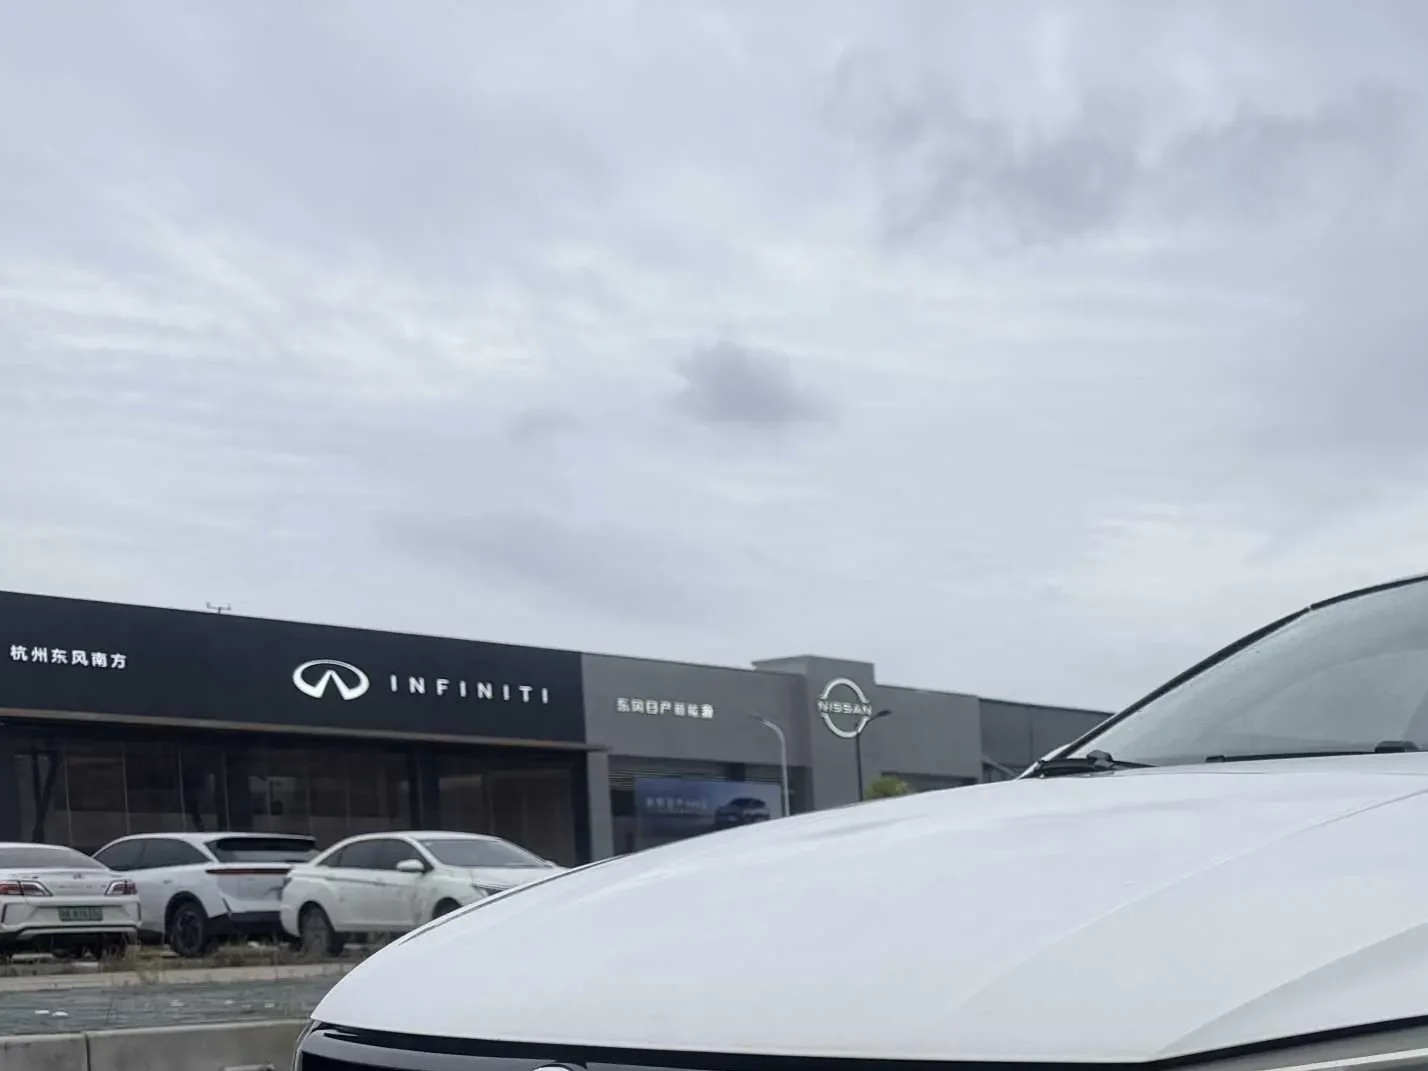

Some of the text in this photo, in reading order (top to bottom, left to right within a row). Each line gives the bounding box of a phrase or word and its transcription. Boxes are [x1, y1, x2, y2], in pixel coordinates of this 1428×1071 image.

[10, 644, 127, 669] 杭州东风南方
[390, 674, 549, 704] INFINITI
[817, 699, 873, 716] NISSAN
